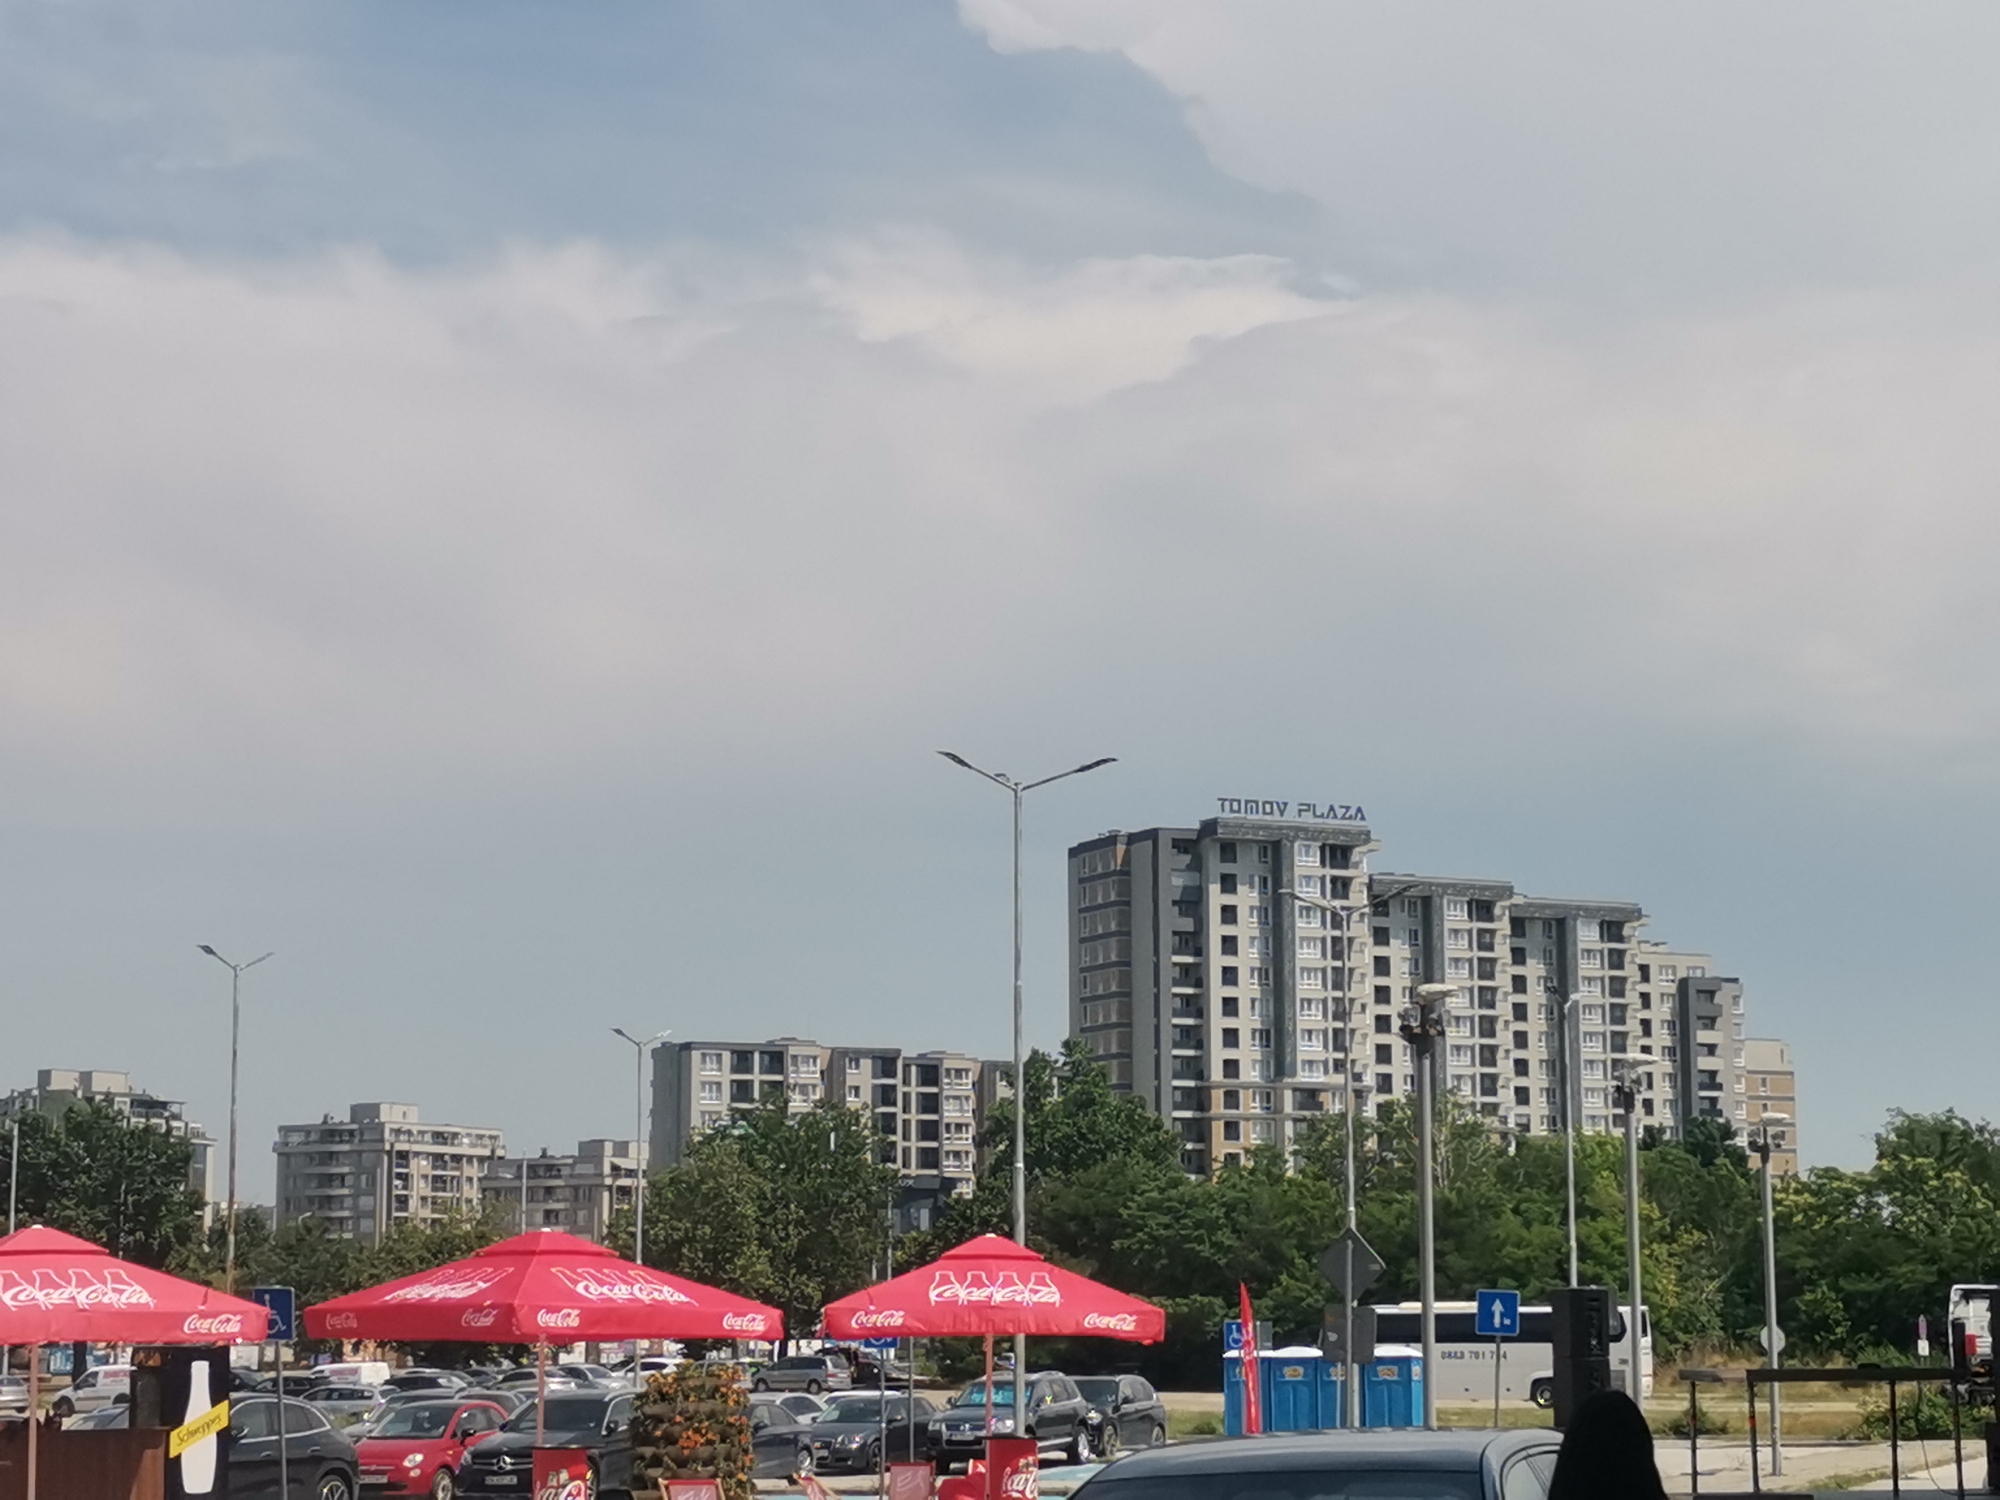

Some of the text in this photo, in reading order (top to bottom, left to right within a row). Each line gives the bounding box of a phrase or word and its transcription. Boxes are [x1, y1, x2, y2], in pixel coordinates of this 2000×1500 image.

[1217, 797, 1367, 821] TOMOV PLAZA
[1489, 1350, 1508, 1361] 74
